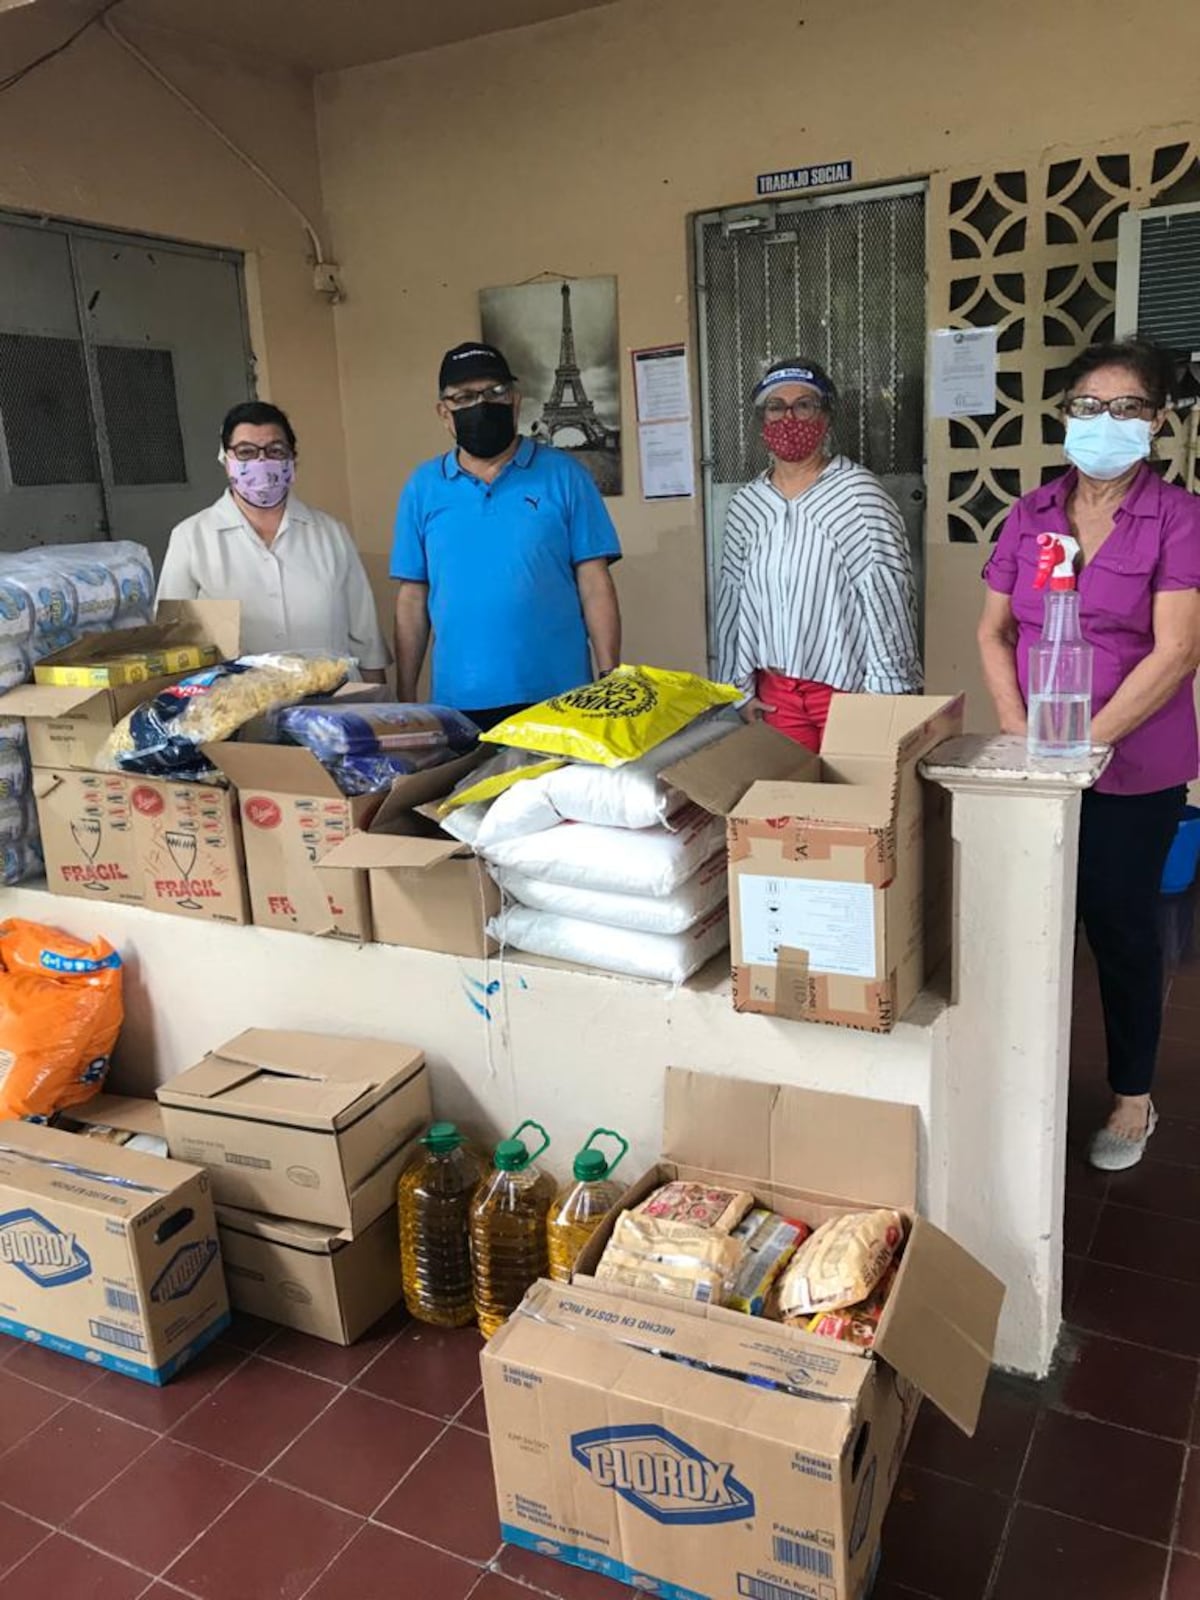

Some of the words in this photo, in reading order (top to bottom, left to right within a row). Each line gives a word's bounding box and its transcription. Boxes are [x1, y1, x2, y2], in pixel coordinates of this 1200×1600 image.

[760, 170, 809, 193] TRABAJO
[811, 163, 849, 186] SOCIAL
[60, 863, 129, 882] FRAGIL
[154, 880, 222, 898] FRAGIL
[0, 1231, 76, 1266] CLOROX
[558, 1299, 584, 1315] RICA
[584, 1307, 620, 1325] COSTA
[620, 1315, 637, 1328] EN
[638, 1319, 676, 1337] HECHO
[589, 1447, 735, 1505] CLOROX
[756, 1569, 790, 1586] COSTA
[793, 1580, 817, 1596] RICA
